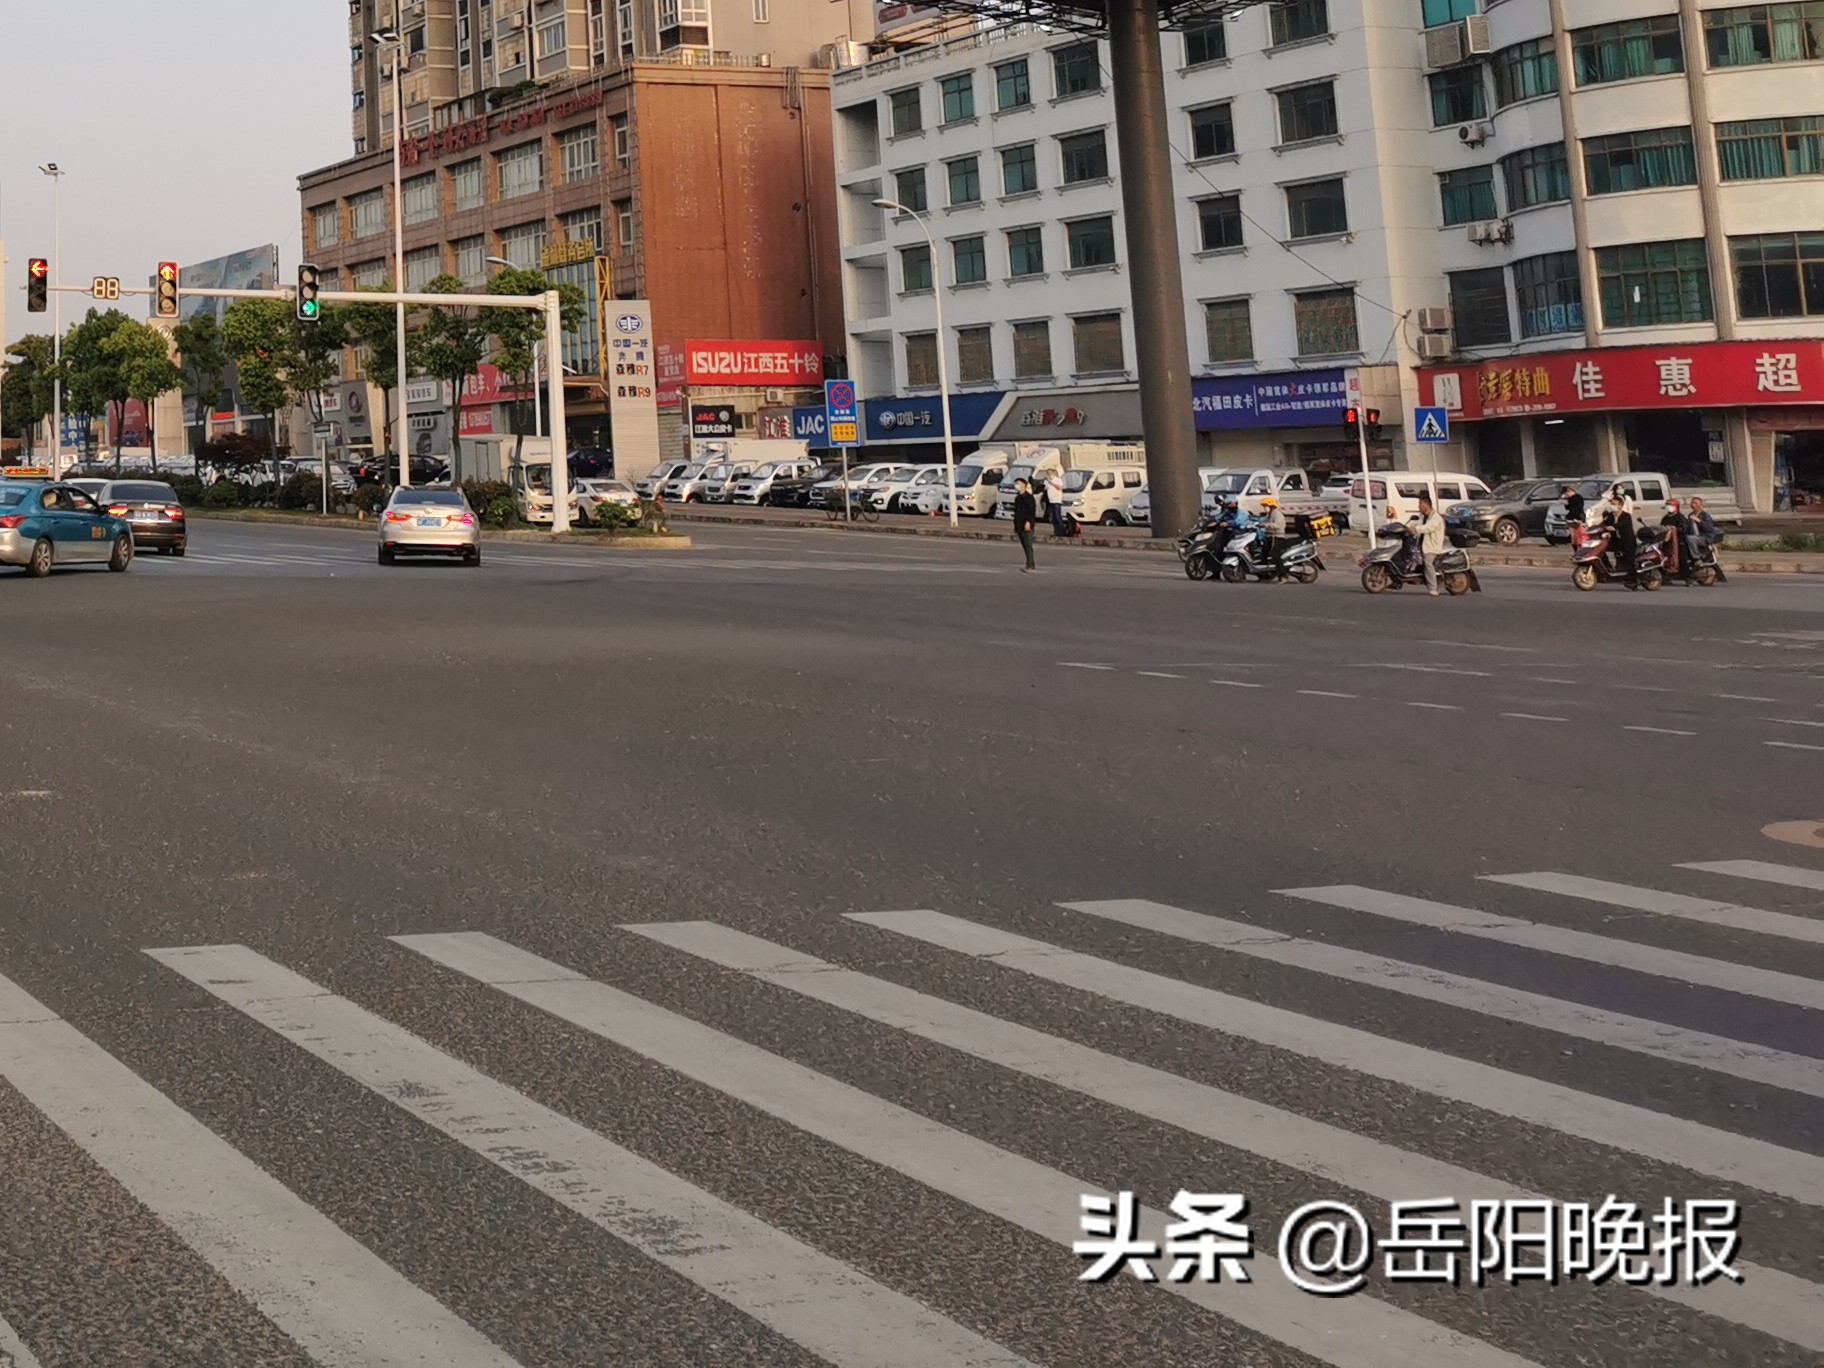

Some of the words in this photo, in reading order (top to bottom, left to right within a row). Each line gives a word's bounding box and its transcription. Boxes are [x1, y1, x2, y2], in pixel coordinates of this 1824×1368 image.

[612, 338, 649, 348] 中国一汽
[692, 351, 741, 374] ISUZU
[743, 352, 819, 374] 江西五十铃
[1572, 352, 1802, 400] 佳惠超
[1192, 393, 1255, 412] 北汽福田皮卡
[696, 412, 716, 422] JAC
[797, 414, 825, 435] JAC
[896, 410, 933, 426] 中国一汽
